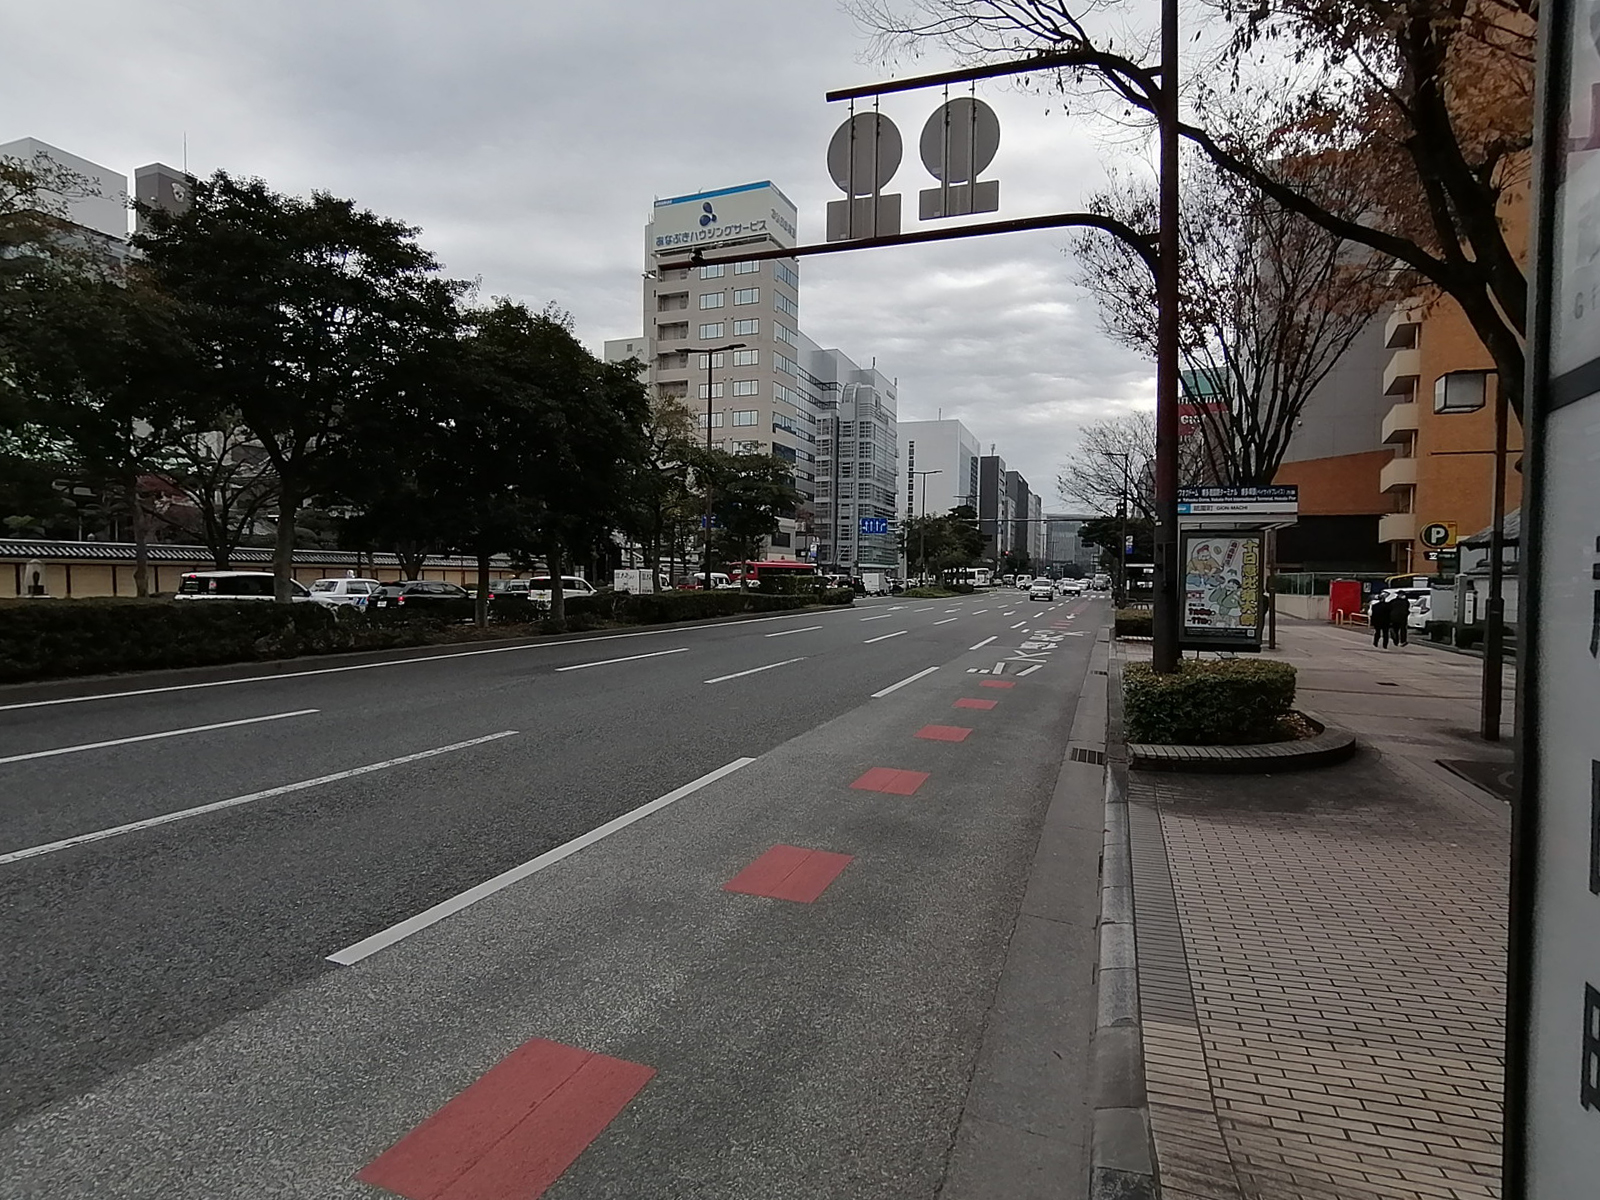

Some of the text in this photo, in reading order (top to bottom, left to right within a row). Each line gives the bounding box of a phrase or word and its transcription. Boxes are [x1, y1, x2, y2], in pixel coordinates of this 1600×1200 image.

[655, 219, 768, 247] あなぶきハウジングサービス
[1431, 527, 1446, 544] P
